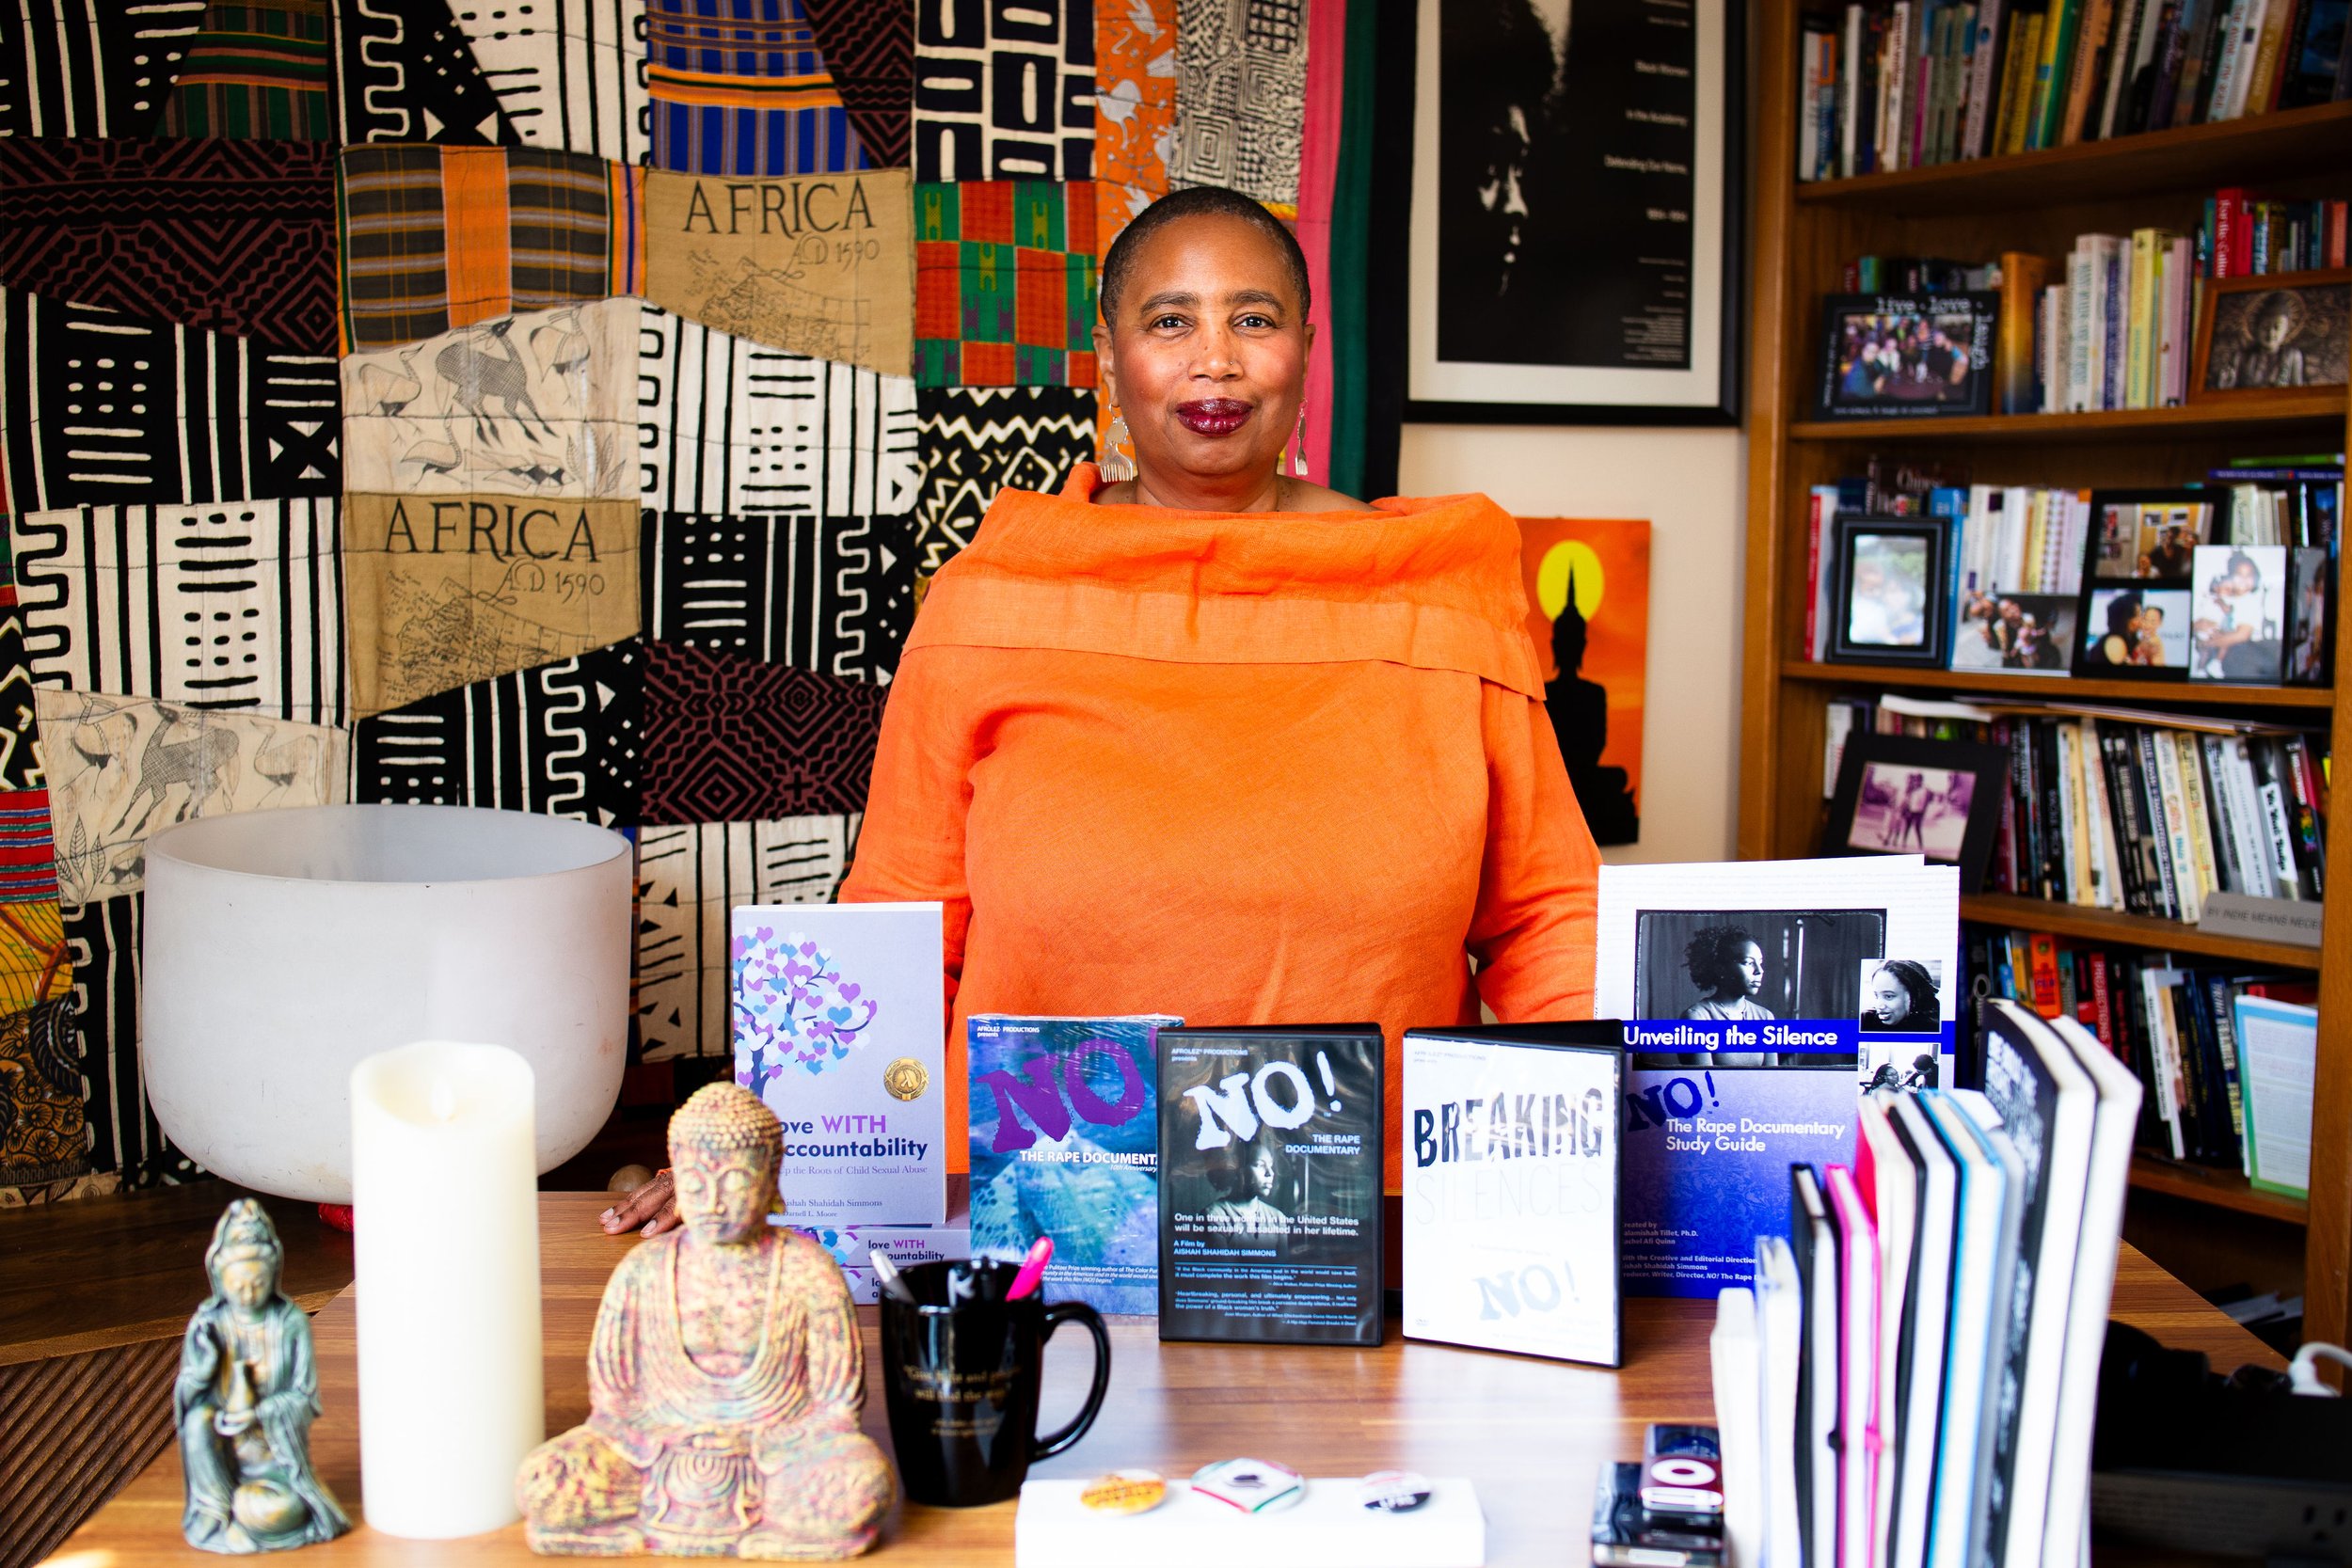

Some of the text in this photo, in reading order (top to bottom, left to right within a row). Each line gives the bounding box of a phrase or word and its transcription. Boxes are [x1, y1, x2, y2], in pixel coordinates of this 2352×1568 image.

[683, 178, 876, 239] AFRICA
[836, 239, 881, 273] 1590
[1929, 296, 1971, 313] love
[384, 498, 601, 563] AFRICA
[555, 570, 606, 605] 1590
[1623, 1024, 1838, 1051] Unveiling the Silence
[1203, 1048, 1248, 1056] PRODUCTIONS
[1183, 1050, 1342, 1150] NO!
[1626, 1070, 1720, 1132] NO!
[779, 1115, 886, 1134] ove WITH
[1414, 1087, 1603, 1168] BREAKING
[1666, 1118, 1846, 1139] The Rape Documentary
[1312, 1133, 1360, 1144] THE RAPE
[1666, 1135, 1766, 1155] Study Guide
[784, 1137, 929, 1161] ccountability
[1019, 1150, 1046, 1163] THE
[1047, 1151, 1080, 1164] RAPE
[1285, 1144, 1361, 1156] DOCUMENTARY
[808, 1165, 832, 1175] Roots
[834, 1165, 843, 1175] of
[847, 1165, 870, 1175] Child
[871, 1165, 900, 1174] Sexual
[901, 1165, 928, 1174] Abuse
[1124, 1164, 1157, 1173] Anniversary
[808, 1198, 845, 1208] Shahidah
[1175, 1213, 1193, 1222] One
[1196, 1213, 1204, 1222] in
[1207, 1213, 1229, 1223] three
[1279, 1215, 1295, 1224] the
[1297, 1215, 1327, 1225] United
[1329, 1216, 1359, 1226] States
[1175, 1224, 1359, 1236] will be sexually assaulted in her lifetime.
[868, 1240, 925, 1249] love WITH
[1197, 1241, 1205, 1249] by
[1202, 1248, 1240, 1257] SHAHIDAH
[1241, 1249, 1277, 1258] SIMMONS
[1676, 1272, 1705, 1280] Director,
[1470, 1260, 1581, 1321] NO!
